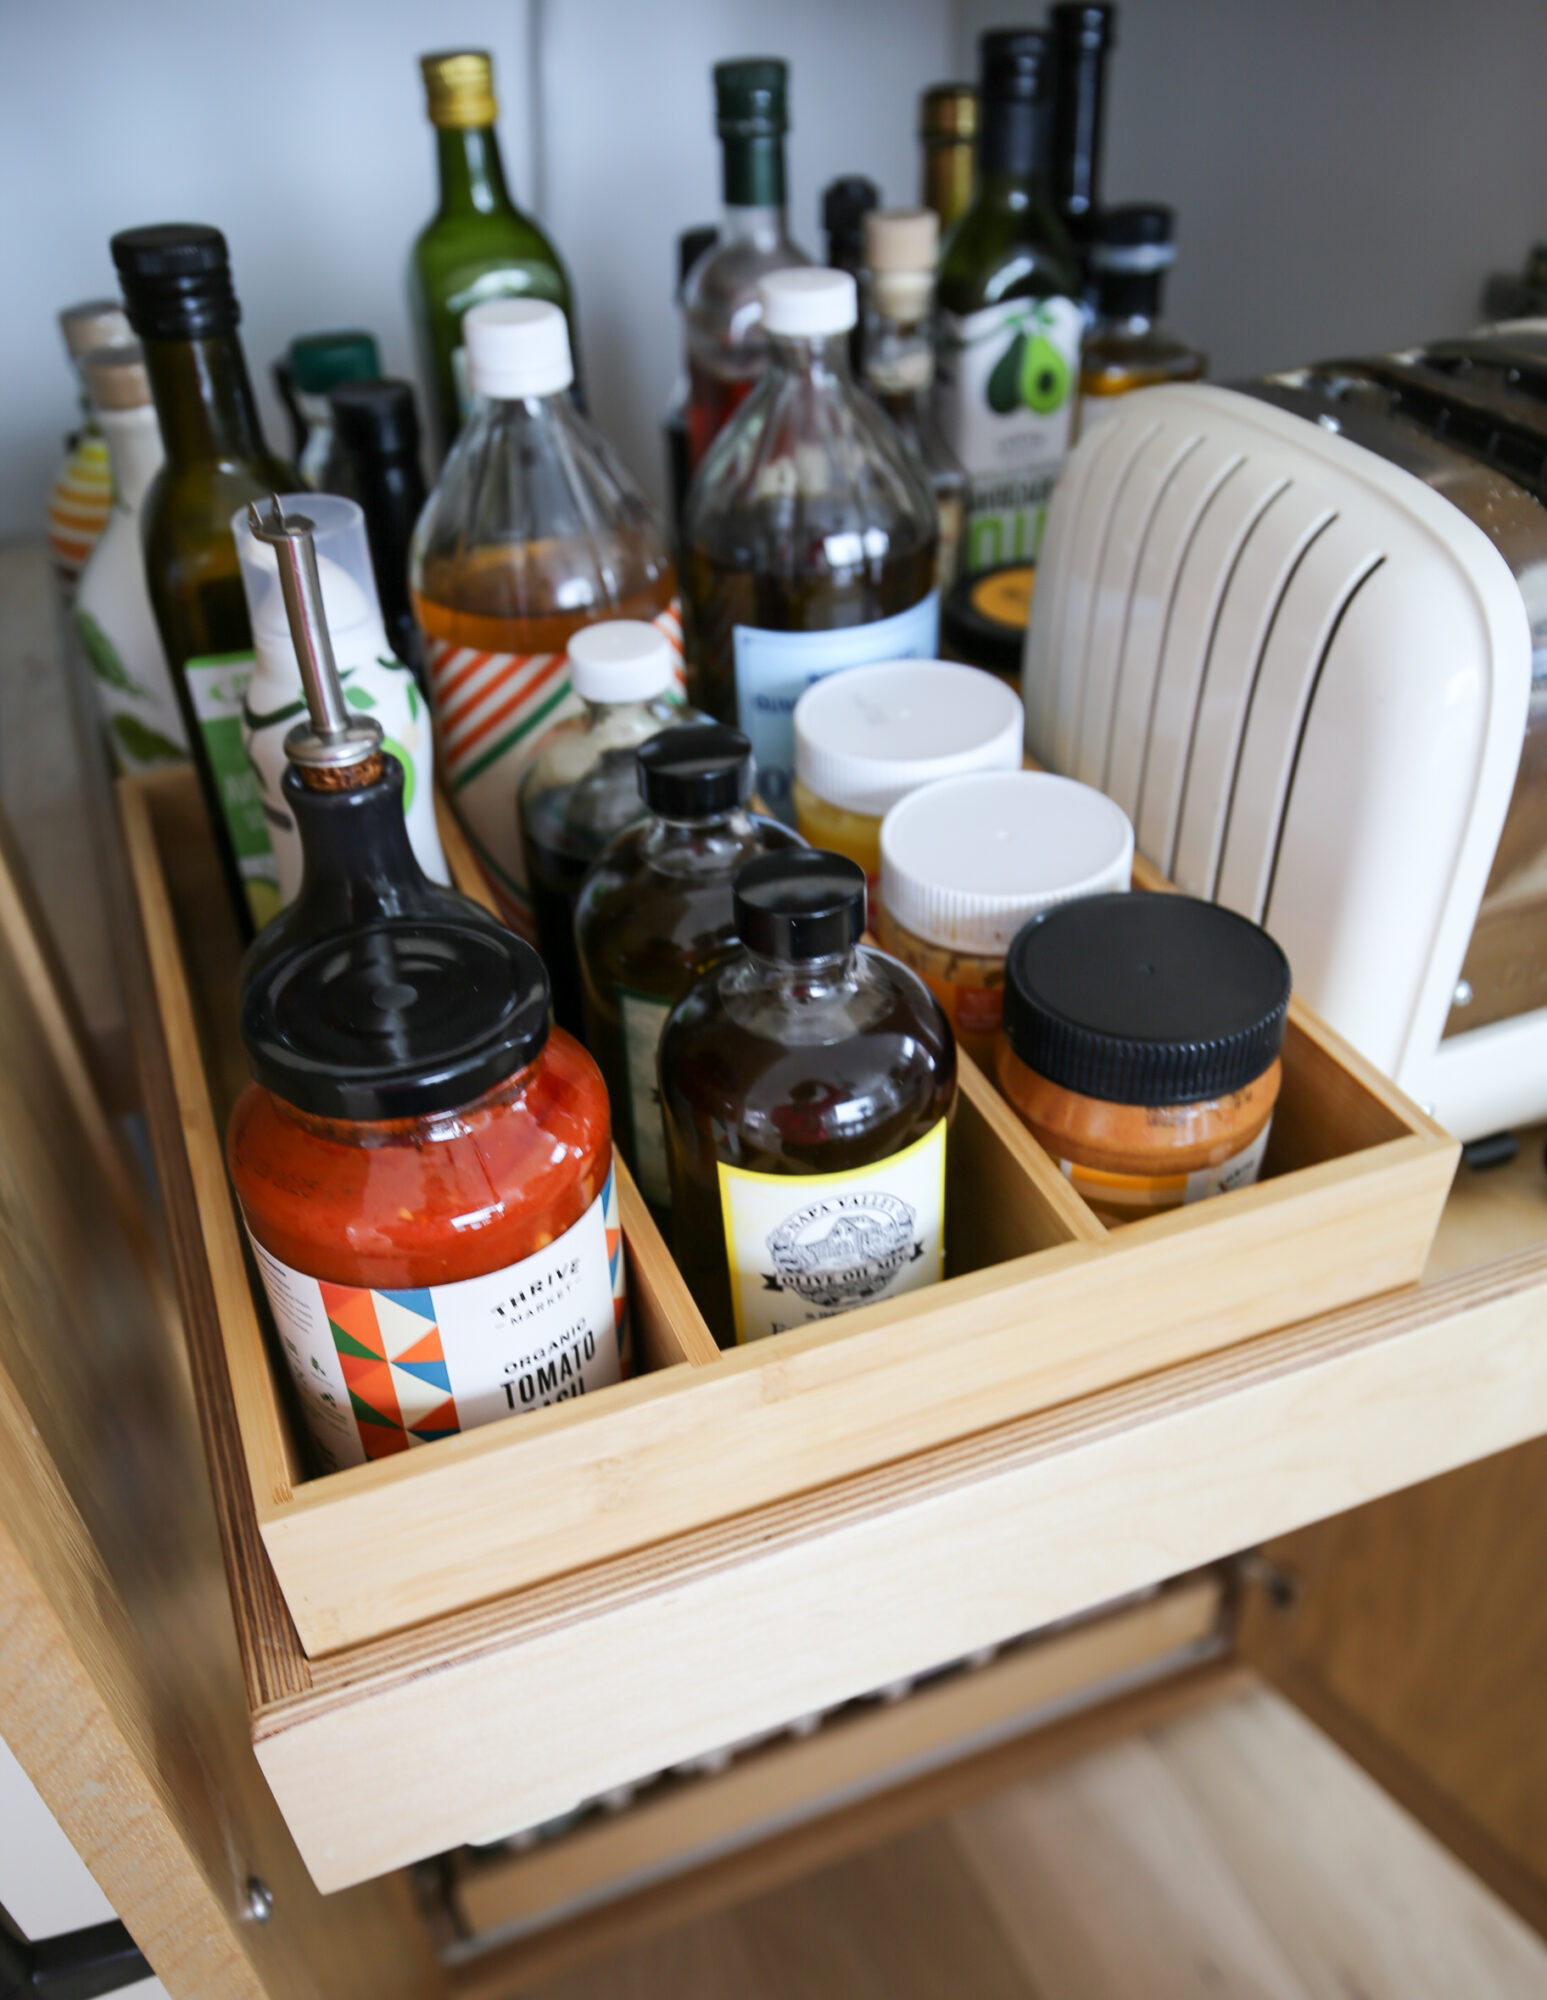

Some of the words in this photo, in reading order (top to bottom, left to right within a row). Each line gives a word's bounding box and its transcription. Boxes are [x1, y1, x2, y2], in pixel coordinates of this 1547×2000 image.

[490, 1257, 580, 1317] THRIVE
[509, 1276, 582, 1326] MARKET
[781, 1274, 834, 1287] OLIVE
[842, 1267, 868, 1283] OIL
[500, 1330, 597, 1411] TOMATO
[504, 1316, 587, 1374] ORGANIC
